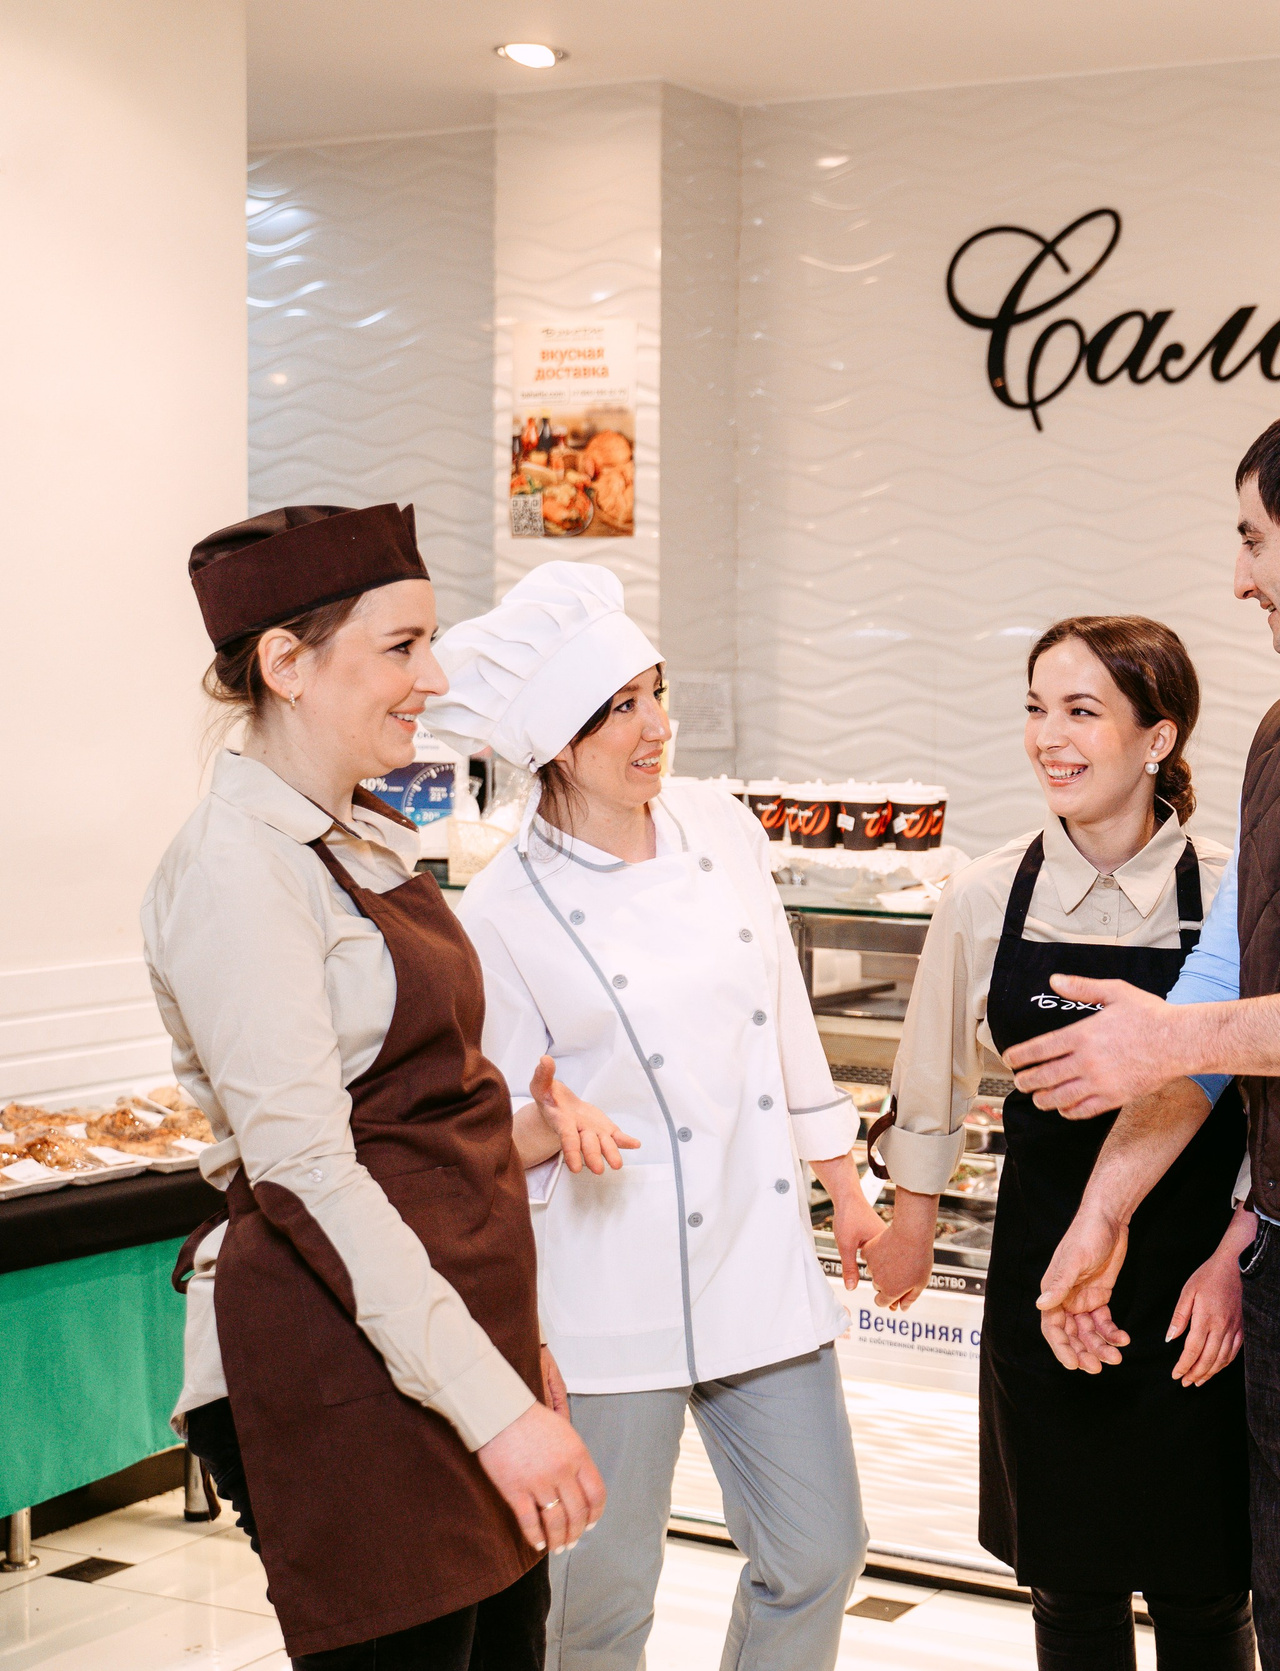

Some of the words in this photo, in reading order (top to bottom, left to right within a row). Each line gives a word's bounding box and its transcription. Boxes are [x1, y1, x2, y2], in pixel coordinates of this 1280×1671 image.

[541, 347, 605, 365] вкусная
[534, 365, 609, 382] доставка
[859, 1309, 963, 1343] Вечерняя
